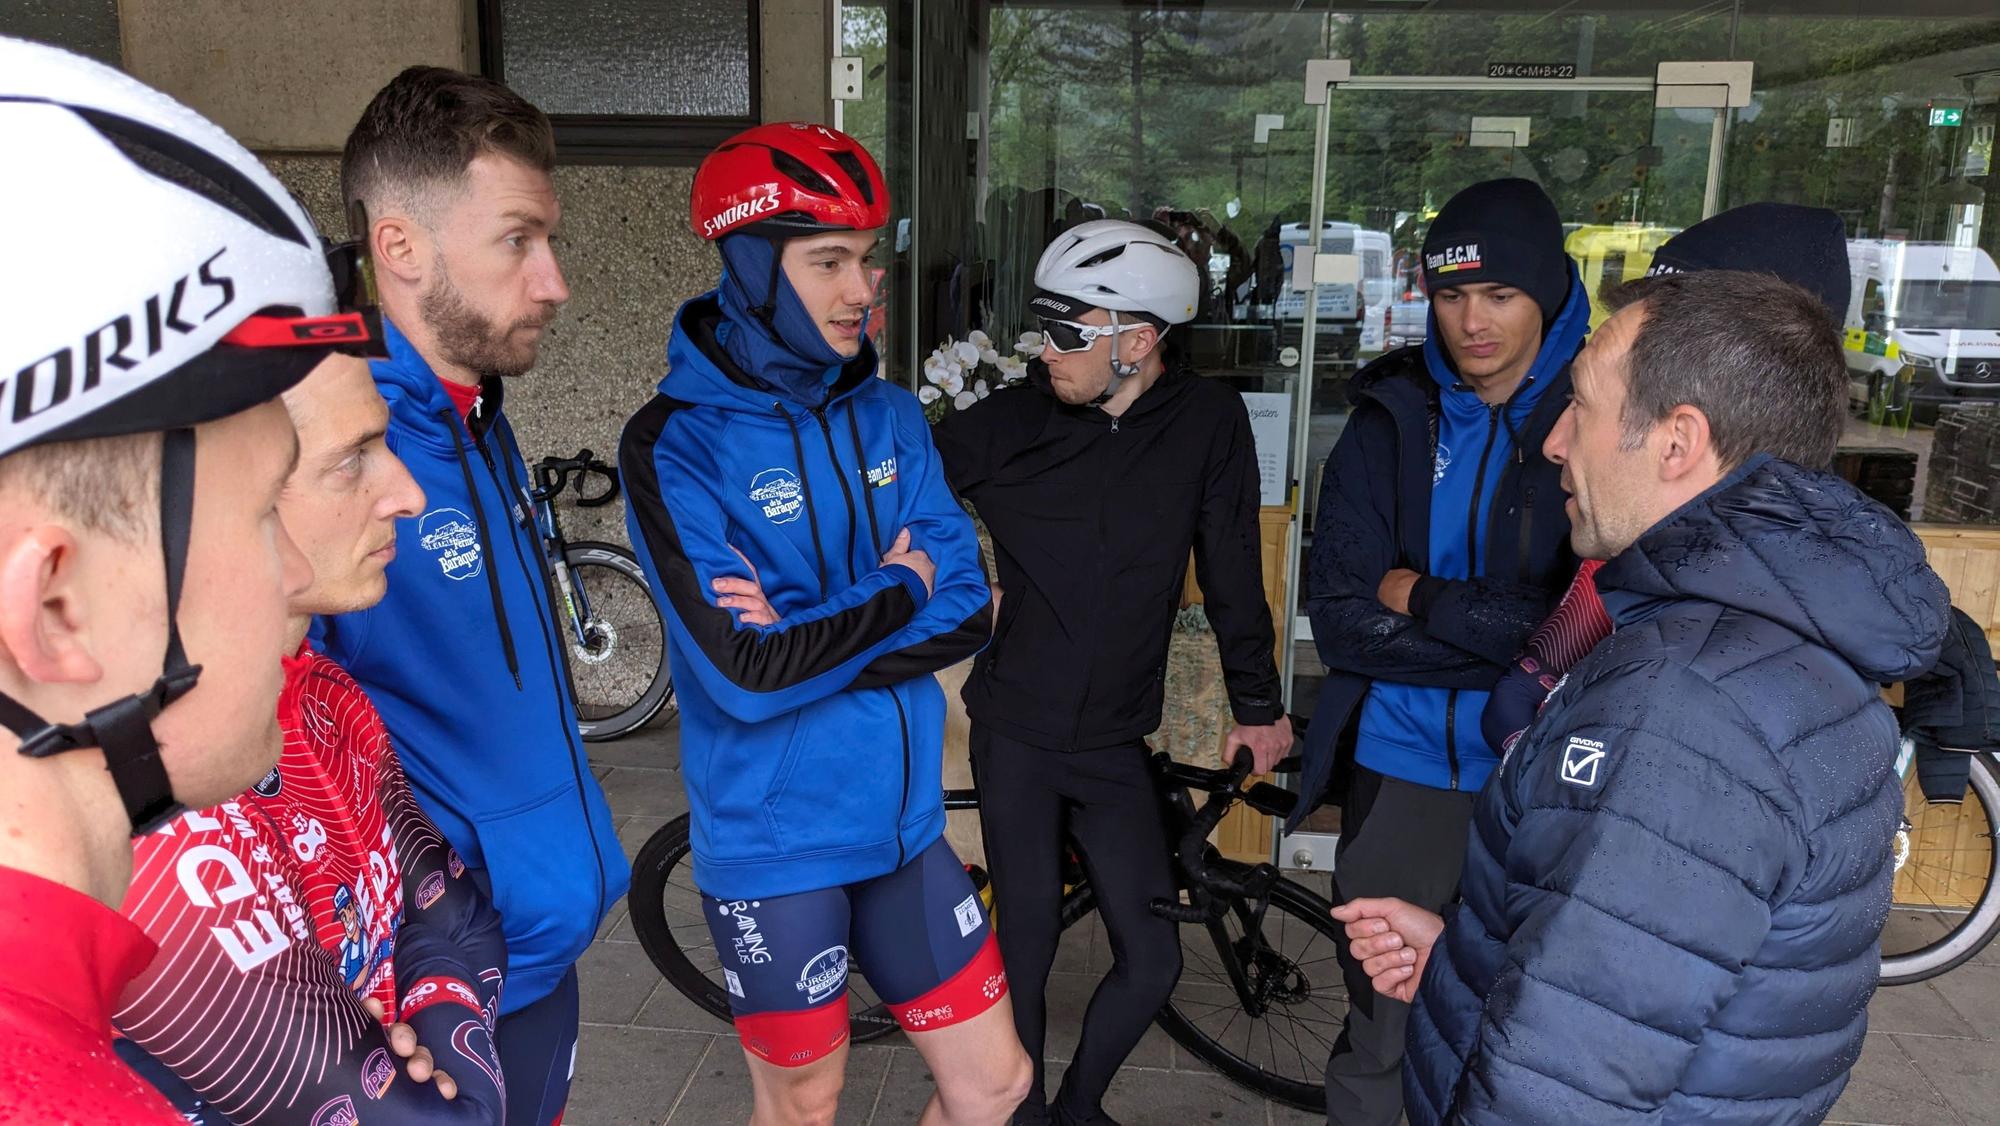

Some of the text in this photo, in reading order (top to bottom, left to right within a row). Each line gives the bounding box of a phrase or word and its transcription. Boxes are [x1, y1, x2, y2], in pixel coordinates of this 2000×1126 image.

[703, 191, 783, 237] S-WORKS
[1425, 243, 1481, 270] Team E.C.W.
[0, 246, 235, 424] ORKS
[762, 499, 800, 518] Baraque
[438, 549, 479, 574] Baraque
[1569, 736, 1604, 749] GIVOVA
[291, 812, 309, 833] 53
[262, 872, 310, 941] HEAT
[728, 899, 773, 964] RAINING
[731, 937, 751, 965] PLUS
[796, 967, 837, 992] BURGER
[912, 1005, 952, 1021] TRAINING
[937, 1013, 954, 1021] PLUS
